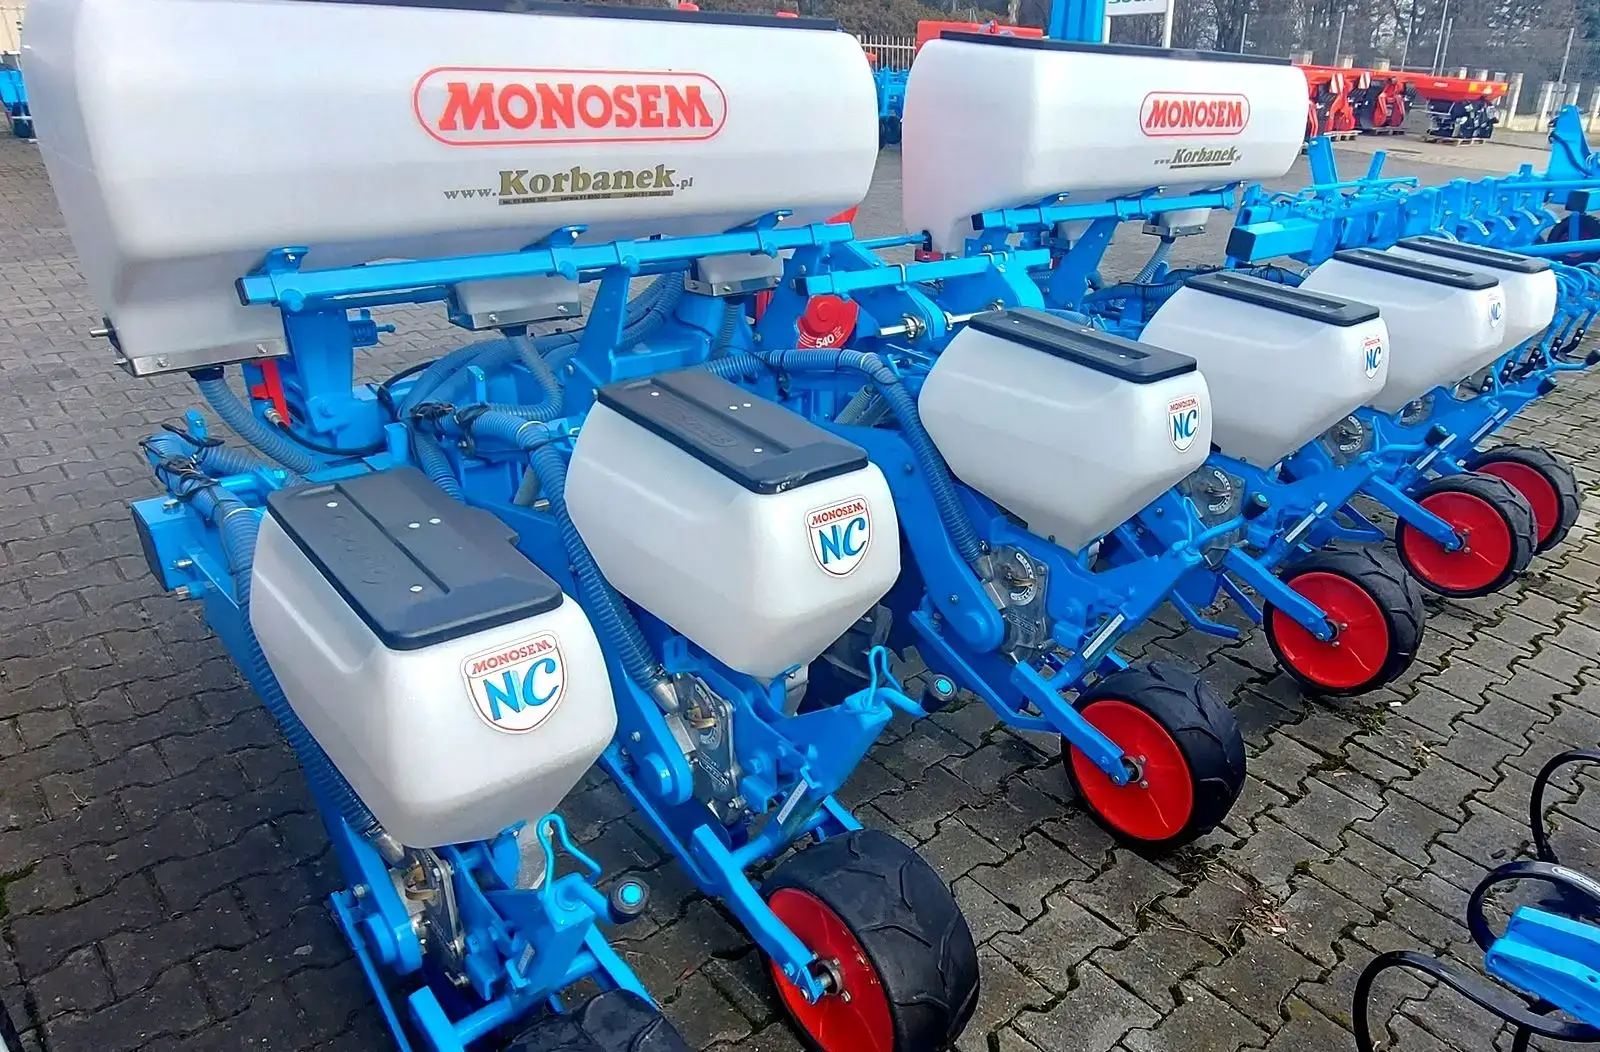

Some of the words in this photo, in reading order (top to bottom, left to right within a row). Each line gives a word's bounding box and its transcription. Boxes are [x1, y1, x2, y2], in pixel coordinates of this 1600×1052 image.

[438, 82, 714, 131] MONOSEM
[1145, 99, 1243, 128] MONOSEM
[443, 164, 694, 200] www.Korbanek.pl
[815, 333, 835, 348] 540
[1365, 346, 1382, 371] NC
[1173, 409, 1197, 441] NC
[811, 502, 864, 525] MONOSEM
[818, 517, 867, 565] NC
[471, 639, 553, 675] MONOSEM
[483, 658, 560, 721] NC
